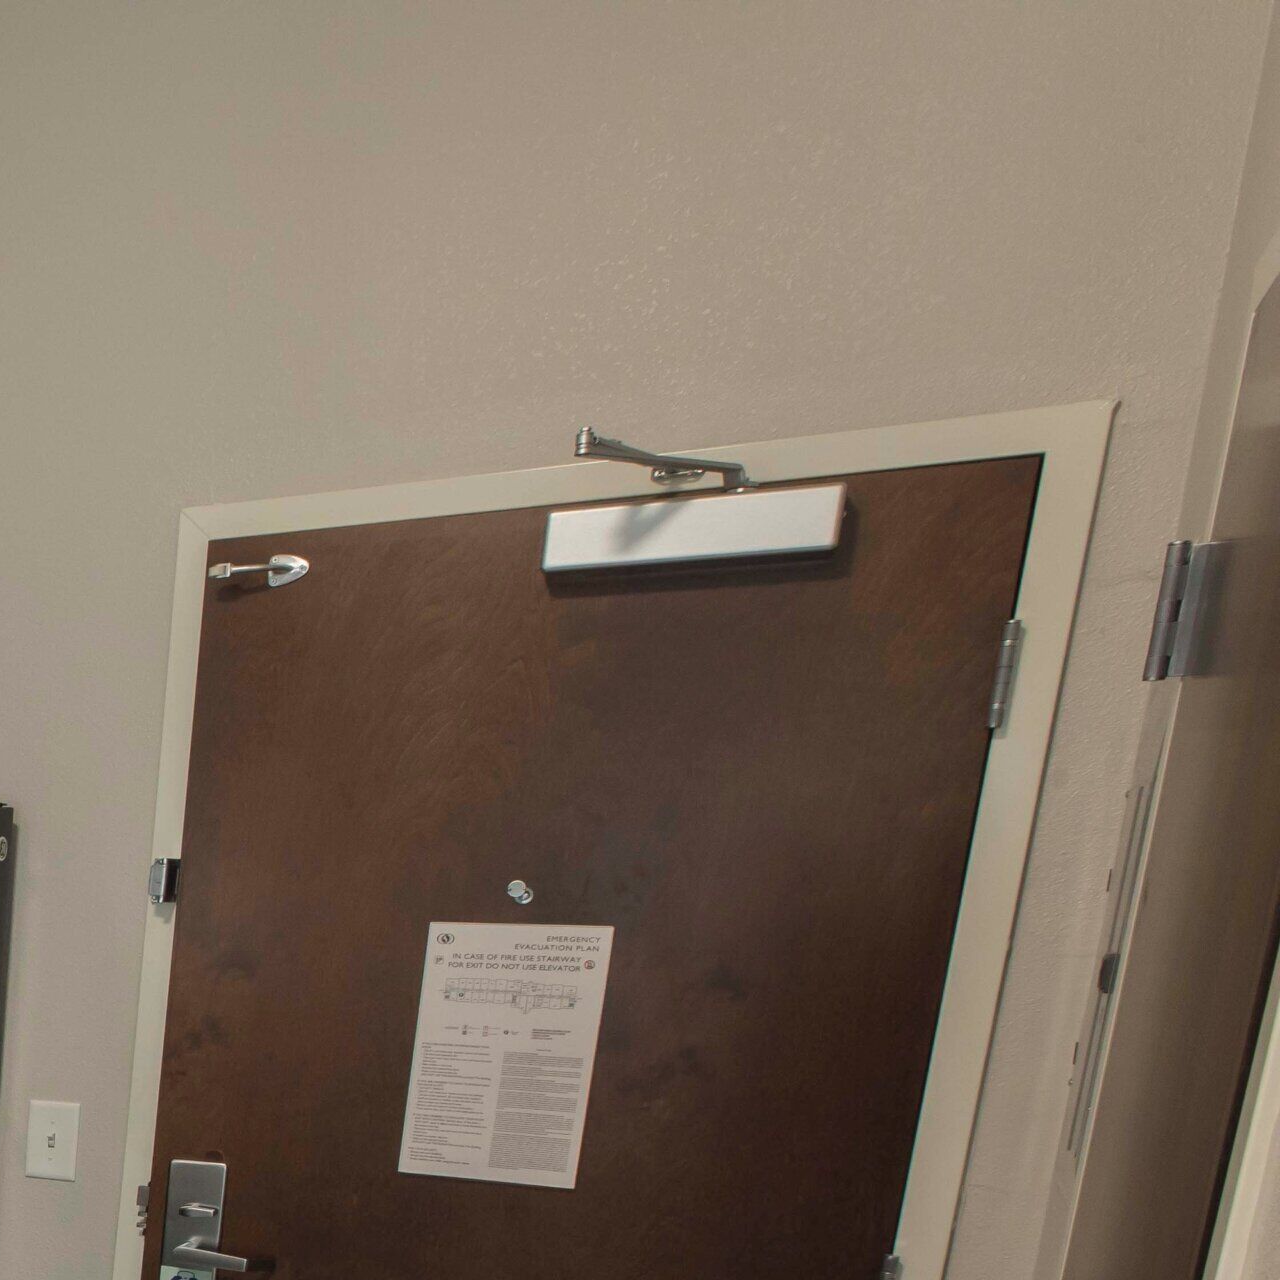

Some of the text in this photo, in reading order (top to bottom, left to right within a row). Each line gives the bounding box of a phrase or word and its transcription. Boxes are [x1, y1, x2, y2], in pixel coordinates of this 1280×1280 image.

[546, 935, 601, 943] EMERGENCY
[514, 943, 573, 952] EVACUATION
[537, 955, 582, 963] STAIRWAY
[539, 964, 581, 972] ELEVATOR
